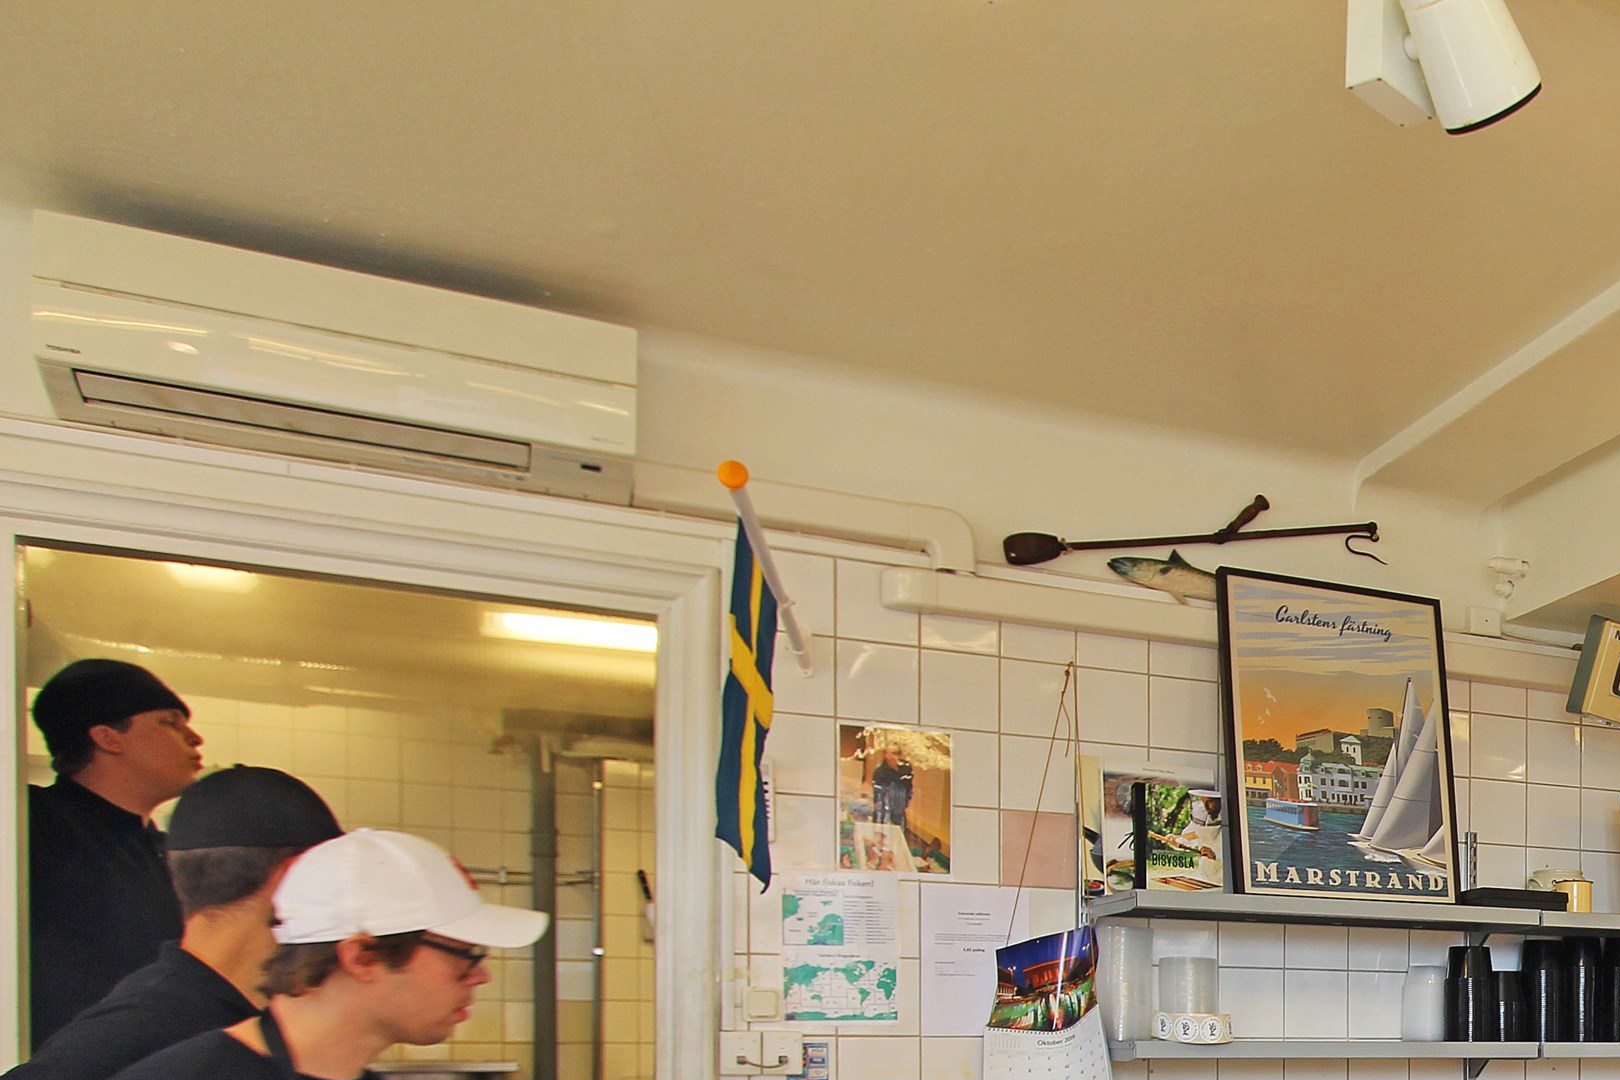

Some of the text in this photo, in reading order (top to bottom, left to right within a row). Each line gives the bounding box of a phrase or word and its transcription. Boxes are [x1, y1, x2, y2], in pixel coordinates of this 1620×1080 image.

[1275, 605, 1393, 643] Carlstens fästning
[1151, 852, 1195, 869] BISYSSLA
[1254, 860, 1446, 892] MARSTRAND
[1037, 1039, 1063, 1047] Oktober
